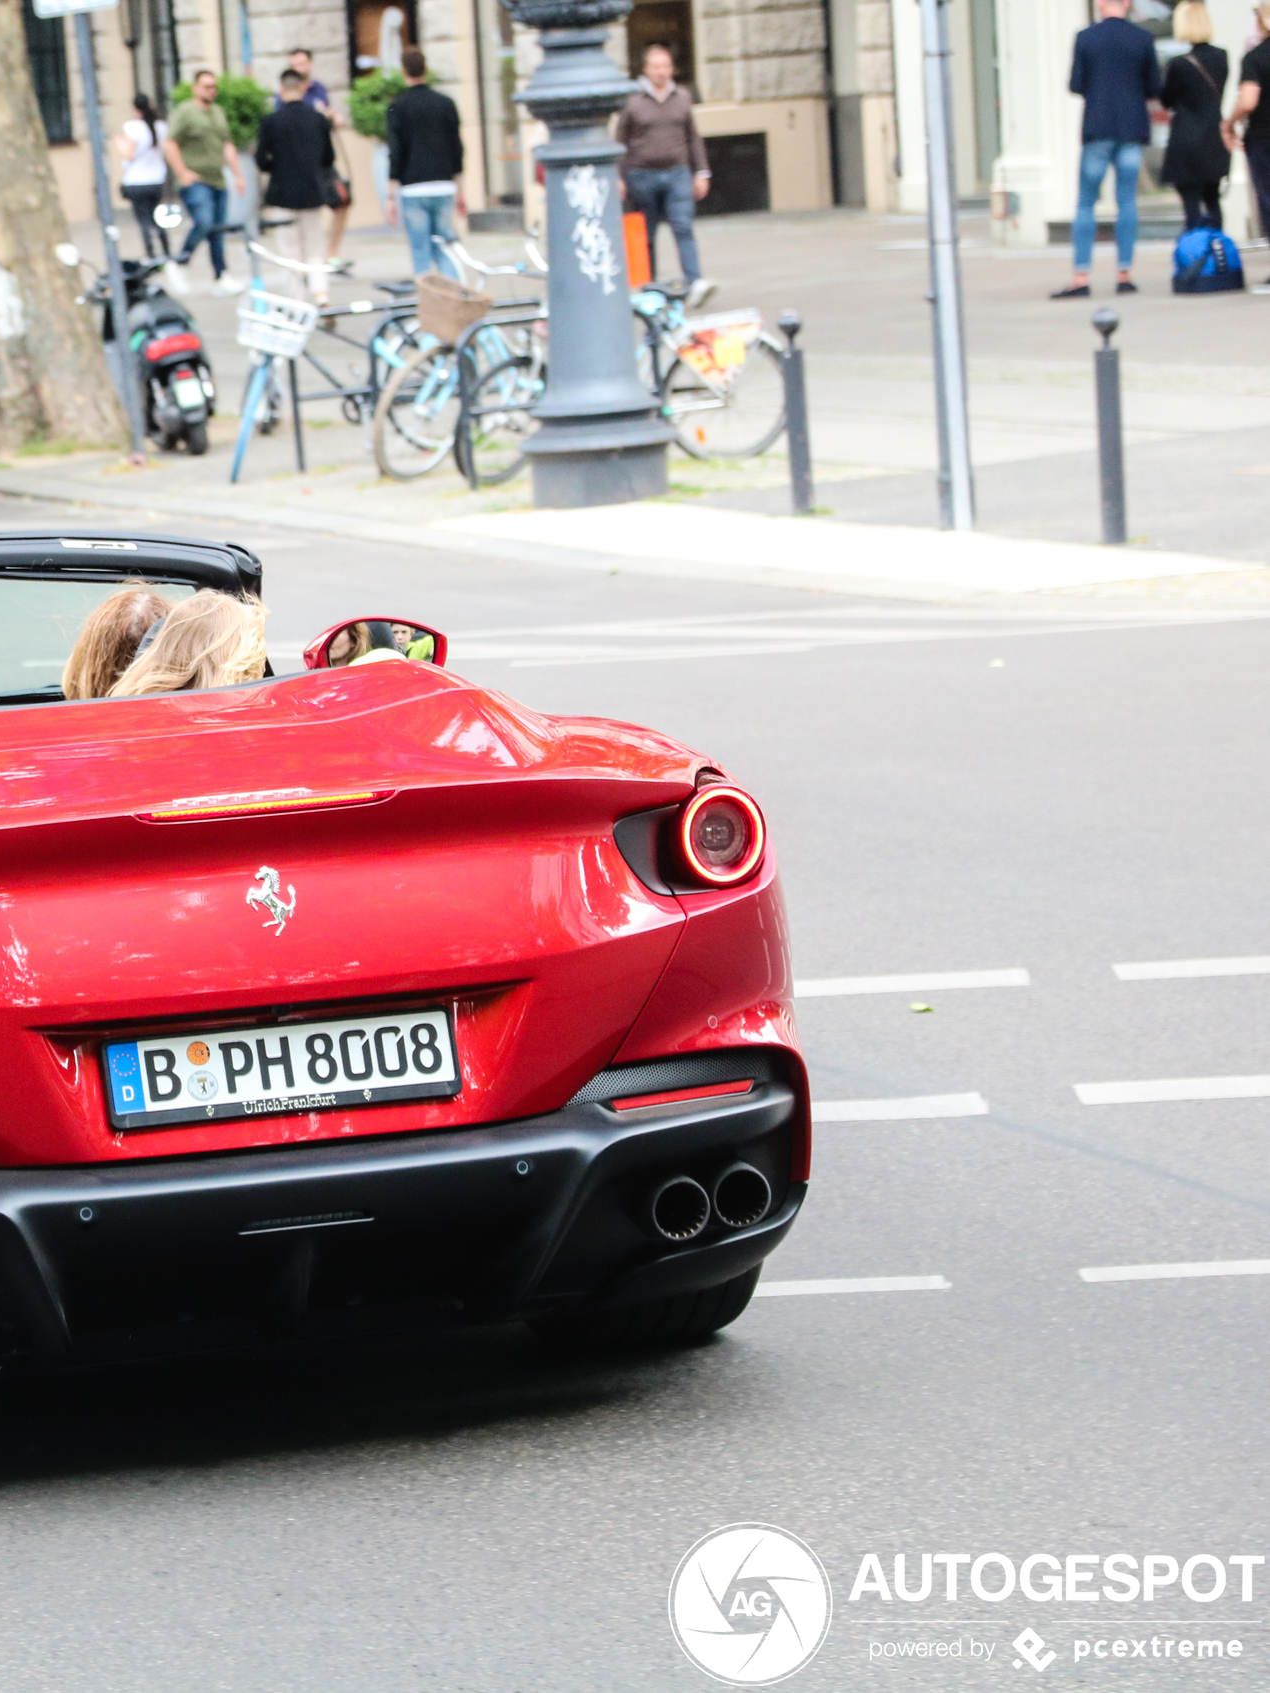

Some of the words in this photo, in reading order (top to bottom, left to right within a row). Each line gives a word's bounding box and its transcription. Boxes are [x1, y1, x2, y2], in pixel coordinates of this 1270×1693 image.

[121, 1085, 135, 1102] D
[143, 1048, 183, 1103] B
[218, 1035, 296, 1094] PH
[304, 1023, 443, 1085] 8008
